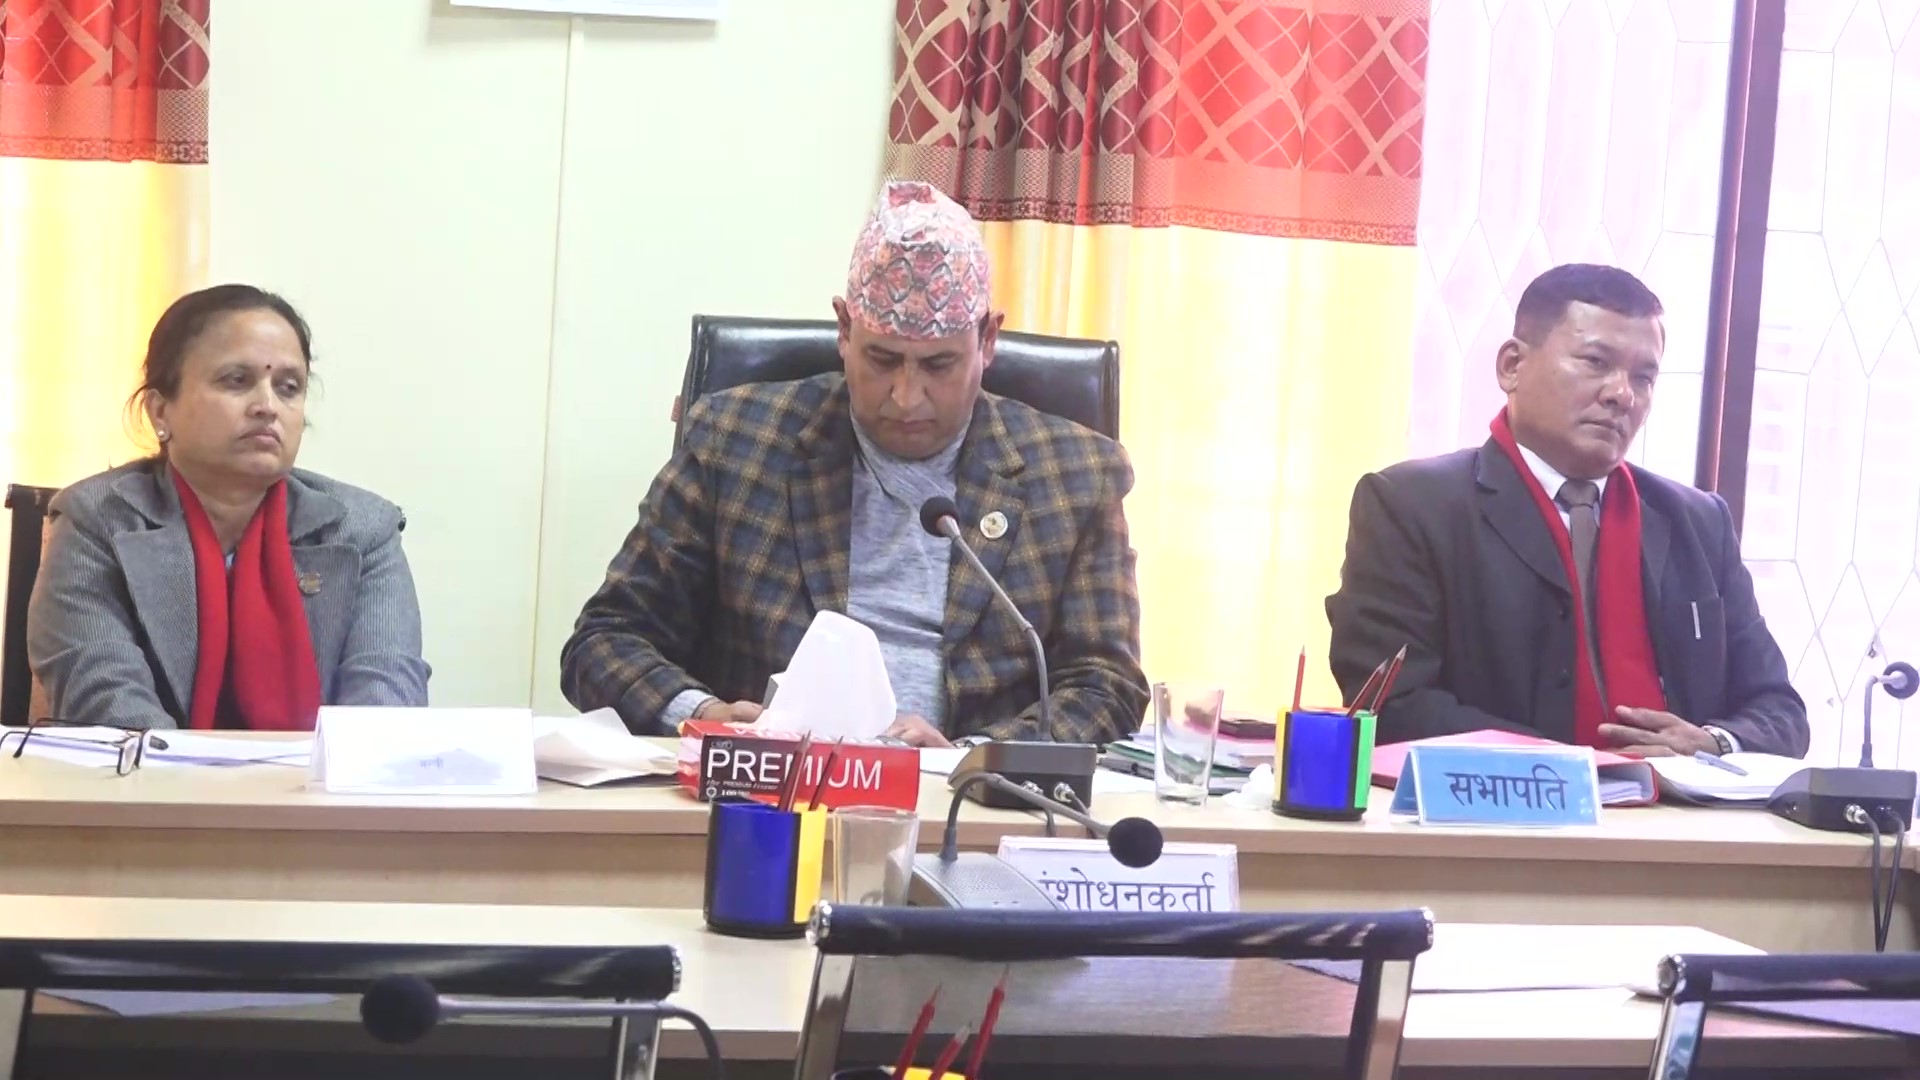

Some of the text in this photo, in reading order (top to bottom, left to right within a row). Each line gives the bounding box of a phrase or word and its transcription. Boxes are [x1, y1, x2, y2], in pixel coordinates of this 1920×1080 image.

[706, 749, 882, 791] PREMIUM
[1444, 764, 1568, 811] सभापति
[1038, 867, 1215, 911] ंशोधनकर्ता
